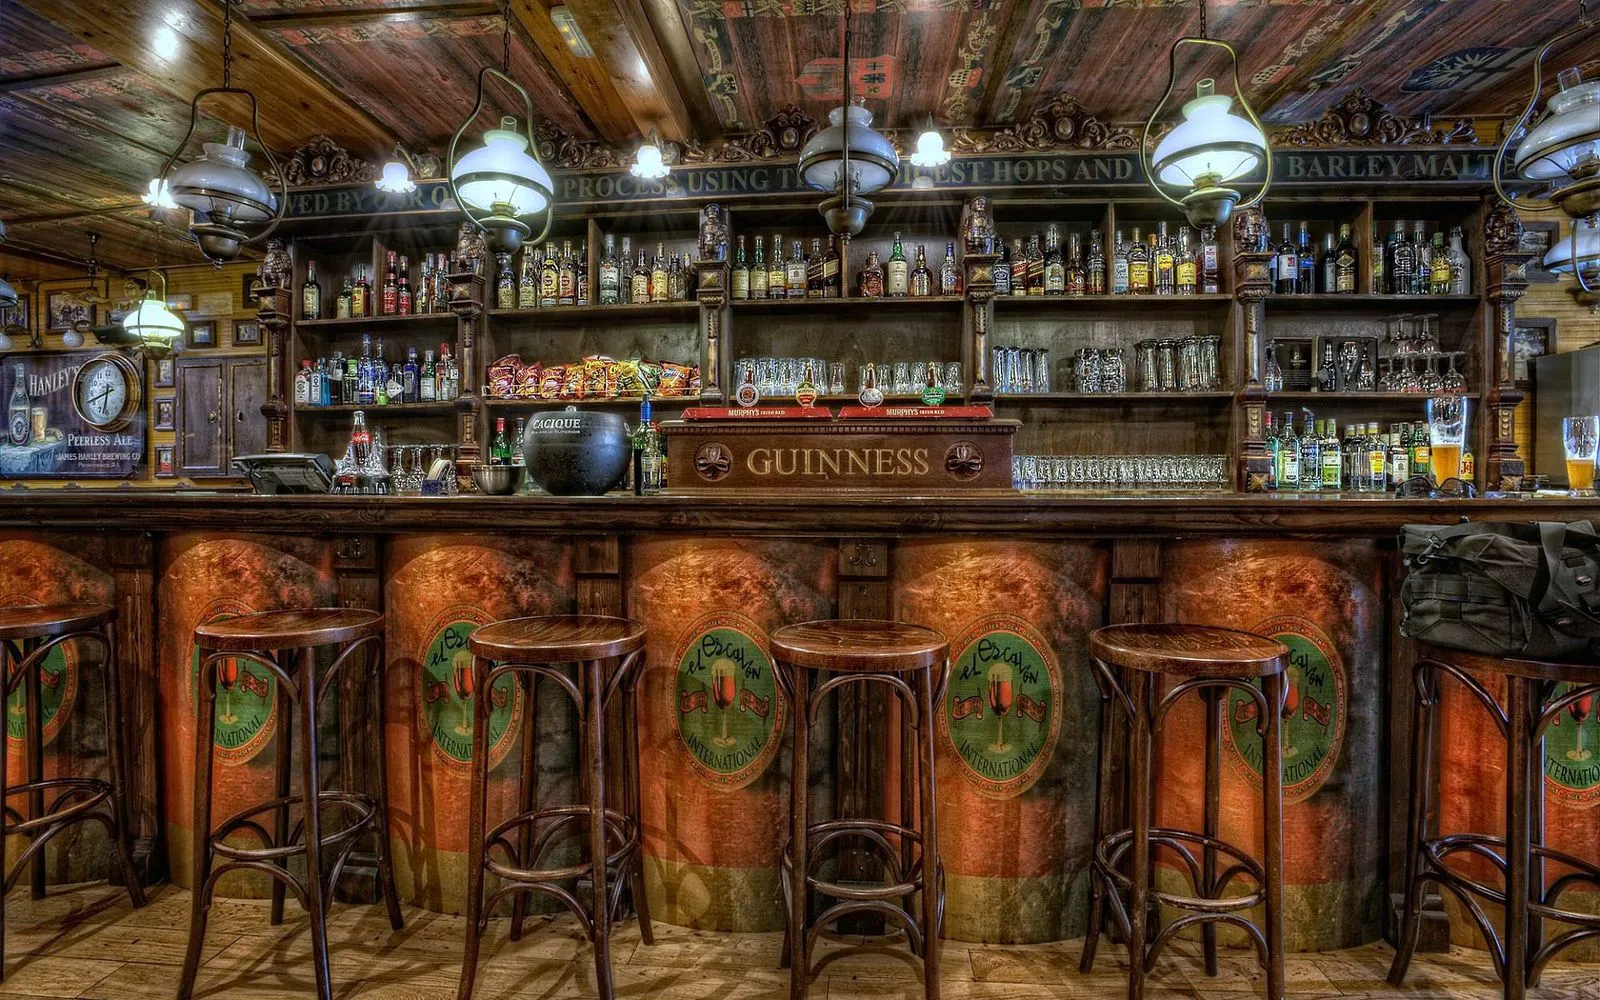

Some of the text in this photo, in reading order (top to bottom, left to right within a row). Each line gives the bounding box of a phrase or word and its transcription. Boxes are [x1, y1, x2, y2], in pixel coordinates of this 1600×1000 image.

[337, 191, 366, 212] BY
[563, 173, 682, 199] PROCESS
[688, 168, 769, 193] USING
[992, 158, 1067, 183] HOPS
[1073, 157, 1133, 181] AND
[1287, 154, 1408, 179] BARLEY
[1413, 153, 1496, 178] MALT
[68, 432, 134, 447] PEERLESS ALE
[533, 418, 581, 430] CACIQUE
[747, 448, 930, 476] GUINNESS
[687, 731, 764, 771] INTERNATIONAL
[960, 739, 1039, 778] INTERNATIONAL
